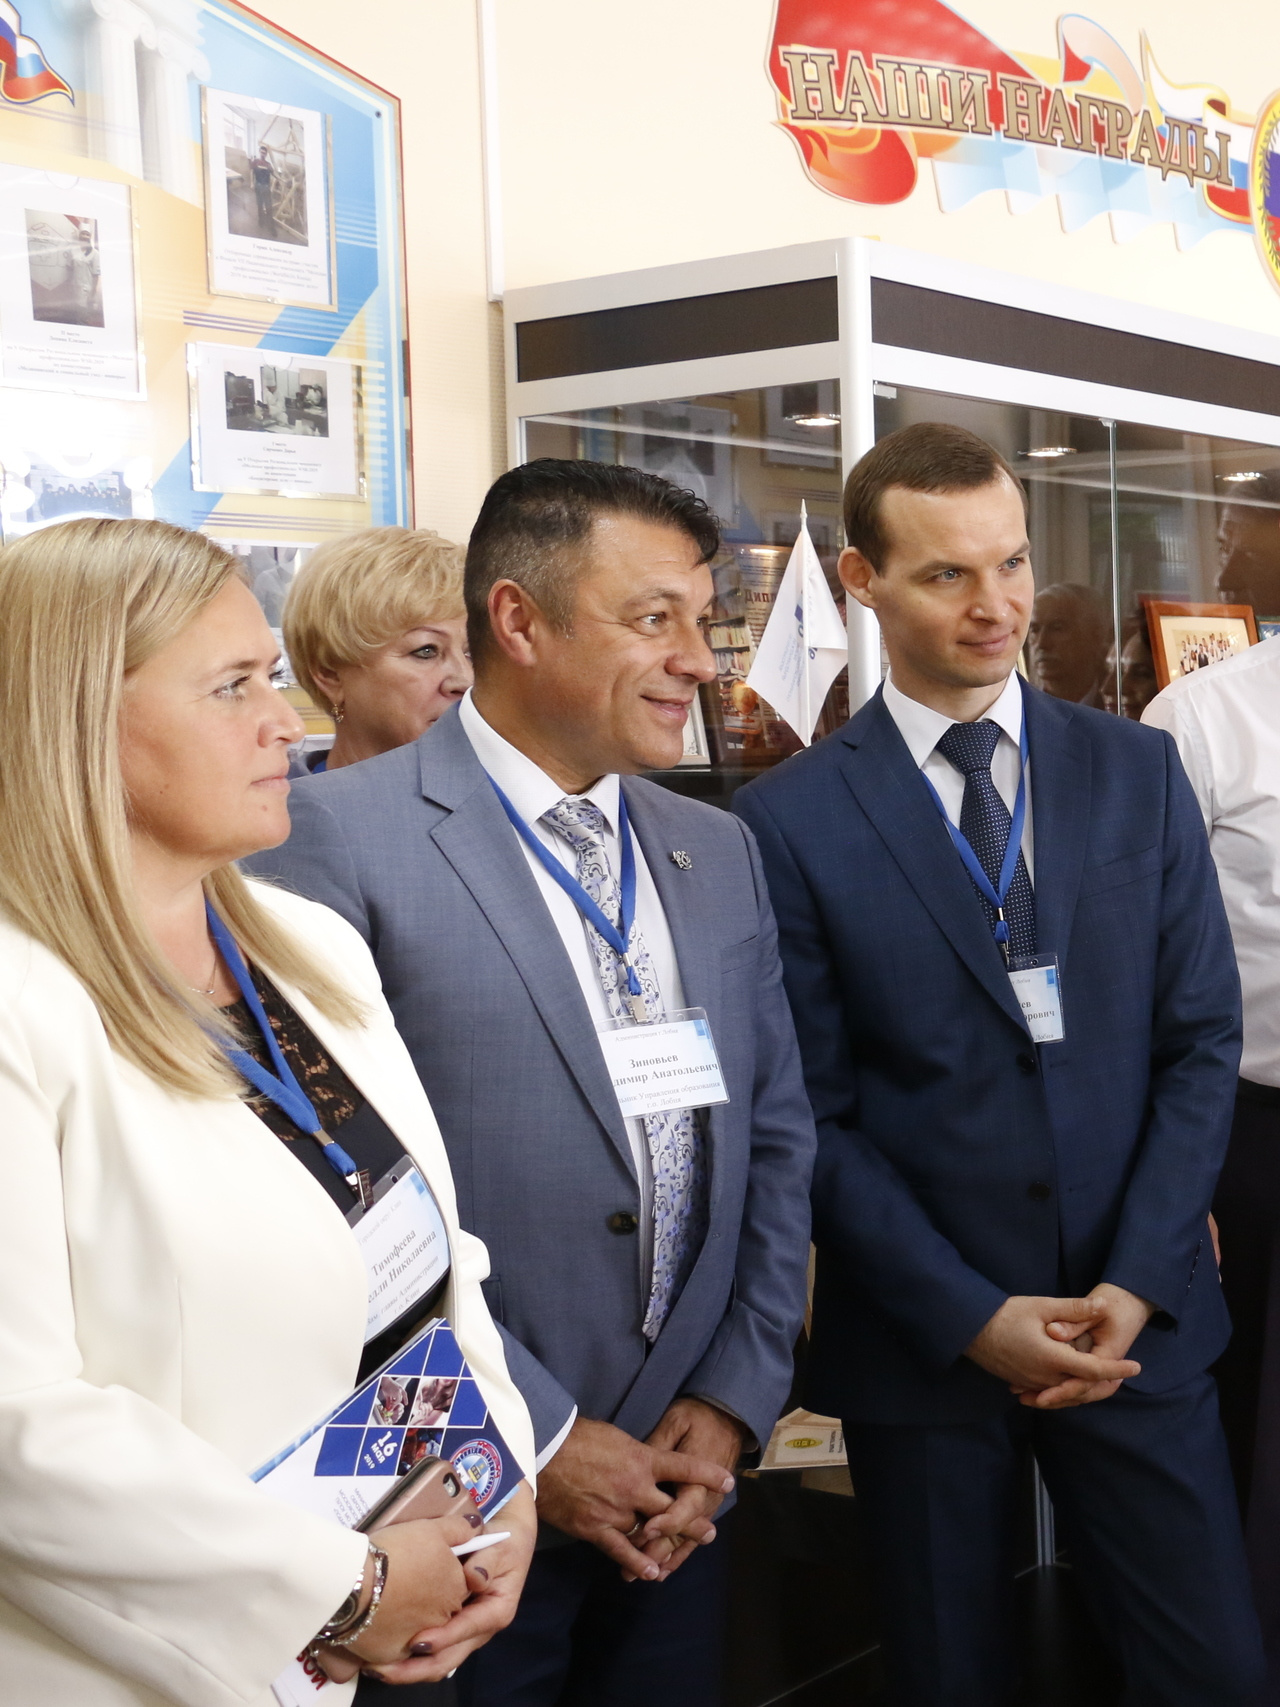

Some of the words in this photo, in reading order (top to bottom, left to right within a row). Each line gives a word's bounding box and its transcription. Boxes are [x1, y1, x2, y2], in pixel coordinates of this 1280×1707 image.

[779, 49, 993, 137] НАШИ
[1000, 77, 1234, 188] НАГРАДЫ
[629, 1054, 679, 1069] Зиновьев
[614, 1073, 649, 1087] димир
[651, 1062, 719, 1079] Анатольевич
[638, 1088, 680, 1100] Управления
[681, 1081, 721, 1093] образования
[660, 1097, 682, 1107] Лобня
[371, 1229, 417, 1277] Тимофеева
[368, 1280, 389, 1304] елли
[389, 1229, 437, 1283] Николаевна
[378, 1430, 398, 1457] 16
[364, 1453, 376, 1469] 2019
